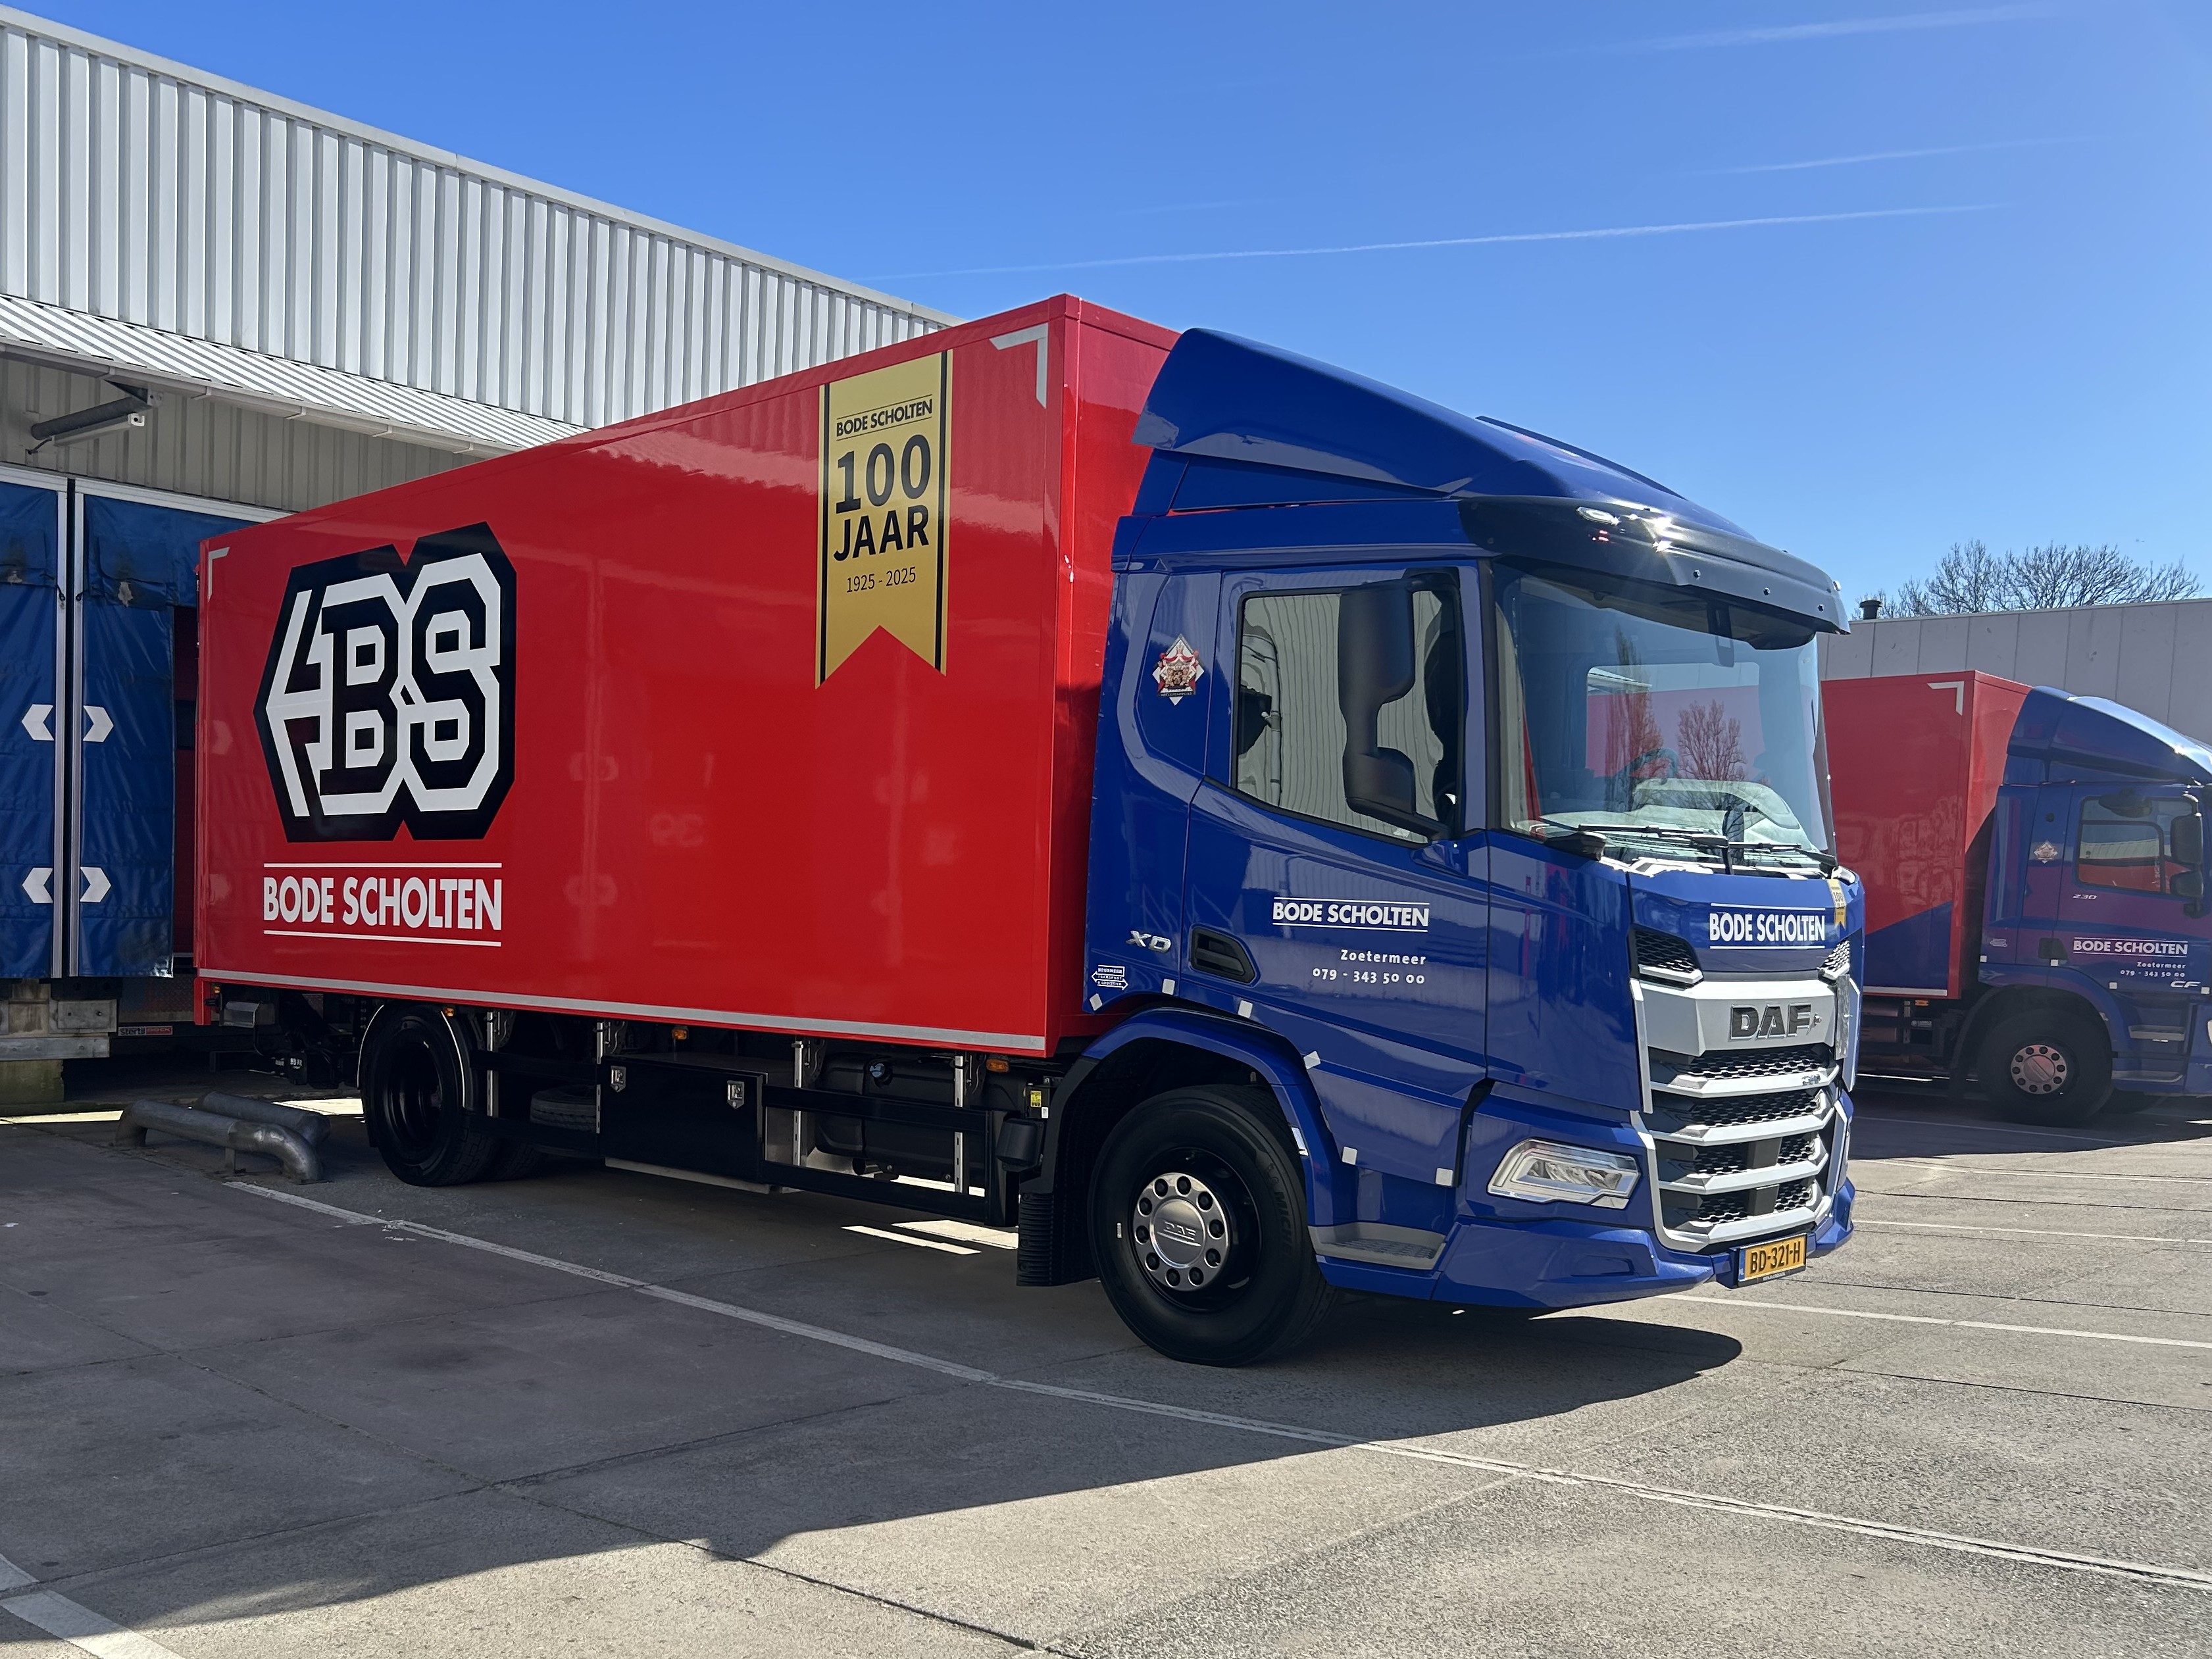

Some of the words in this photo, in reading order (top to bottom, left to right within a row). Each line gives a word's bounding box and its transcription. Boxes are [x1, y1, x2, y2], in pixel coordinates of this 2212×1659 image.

[836, 414, 868, 437] BODE
[870, 399, 932, 429] SCHOLTEN
[836, 434, 931, 514] 100
[833, 505, 930, 562] JAAR
[846, 572, 875, 593] 1925
[886, 566, 916, 587] 2025
[264, 876, 334, 924] BODE
[343, 877, 502, 931] SCHOLTEN
[1272, 902, 1323, 922] BODE
[1326, 904, 1430, 927] SCHOLTEN
[1126, 930, 1172, 953] XD
[1709, 912, 1753, 942] BODE
[1756, 914, 1825, 942] SCHOLTEN
[1340, 949, 1426, 965] Zoetermeer
[2073, 940, 2111, 952] BODE
[2114, 941, 2188, 954] SCHOLTEN
[1313, 968, 1337, 980] 079
[1353, 970, 1377, 983] 343
[1382, 973, 1400, 984] 50
[1405, 974, 1425, 984] 00
[1730, 1003, 1812, 1041] DAF
[1749, 1241, 1801, 1275] BD-321-H
